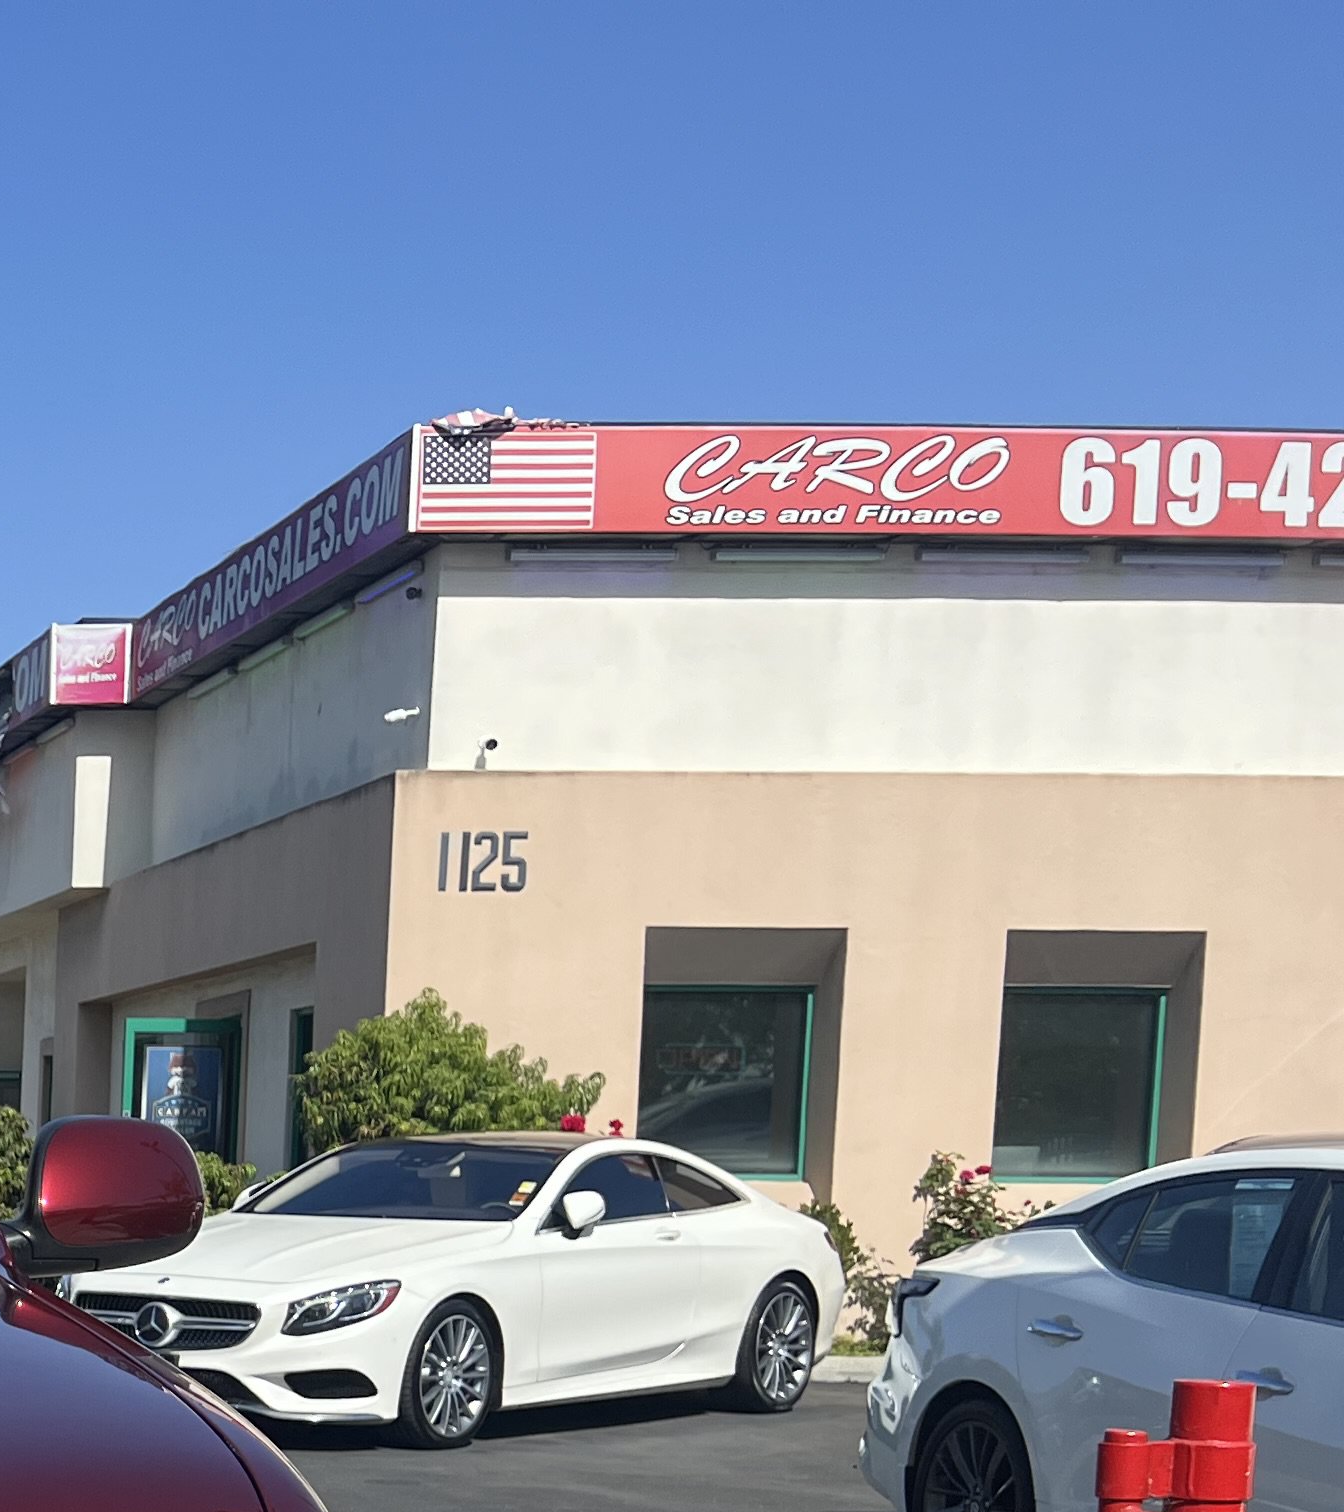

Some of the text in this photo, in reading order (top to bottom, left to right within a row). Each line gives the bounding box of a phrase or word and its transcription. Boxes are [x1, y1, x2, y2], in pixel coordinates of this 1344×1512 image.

[663, 434, 1011, 503] CARCO
[198, 446, 404, 641] CARCOSALES.COM
[665, 505, 1002, 526] Sales and Finance
[438, 831, 529, 892] 1125
